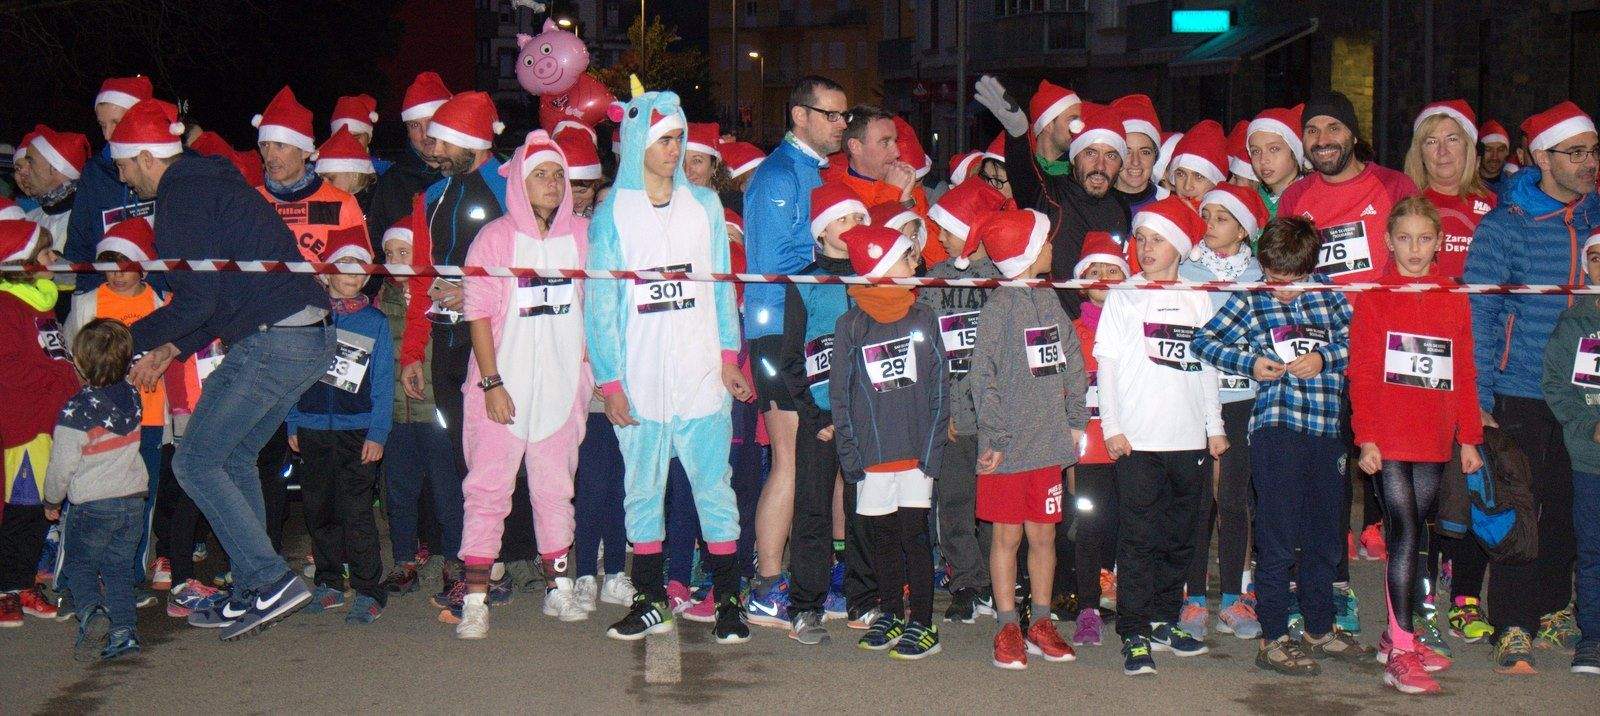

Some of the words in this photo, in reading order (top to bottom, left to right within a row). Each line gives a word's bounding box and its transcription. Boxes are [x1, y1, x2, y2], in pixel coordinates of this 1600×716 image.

[1320, 242, 1348, 263] 76
[542, 287, 548, 303] 1
[650, 281, 683, 301] 301
[1038, 344, 1059, 364] 159
[1157, 340, 1186, 360] 173
[1410, 355, 1434, 375] 13
